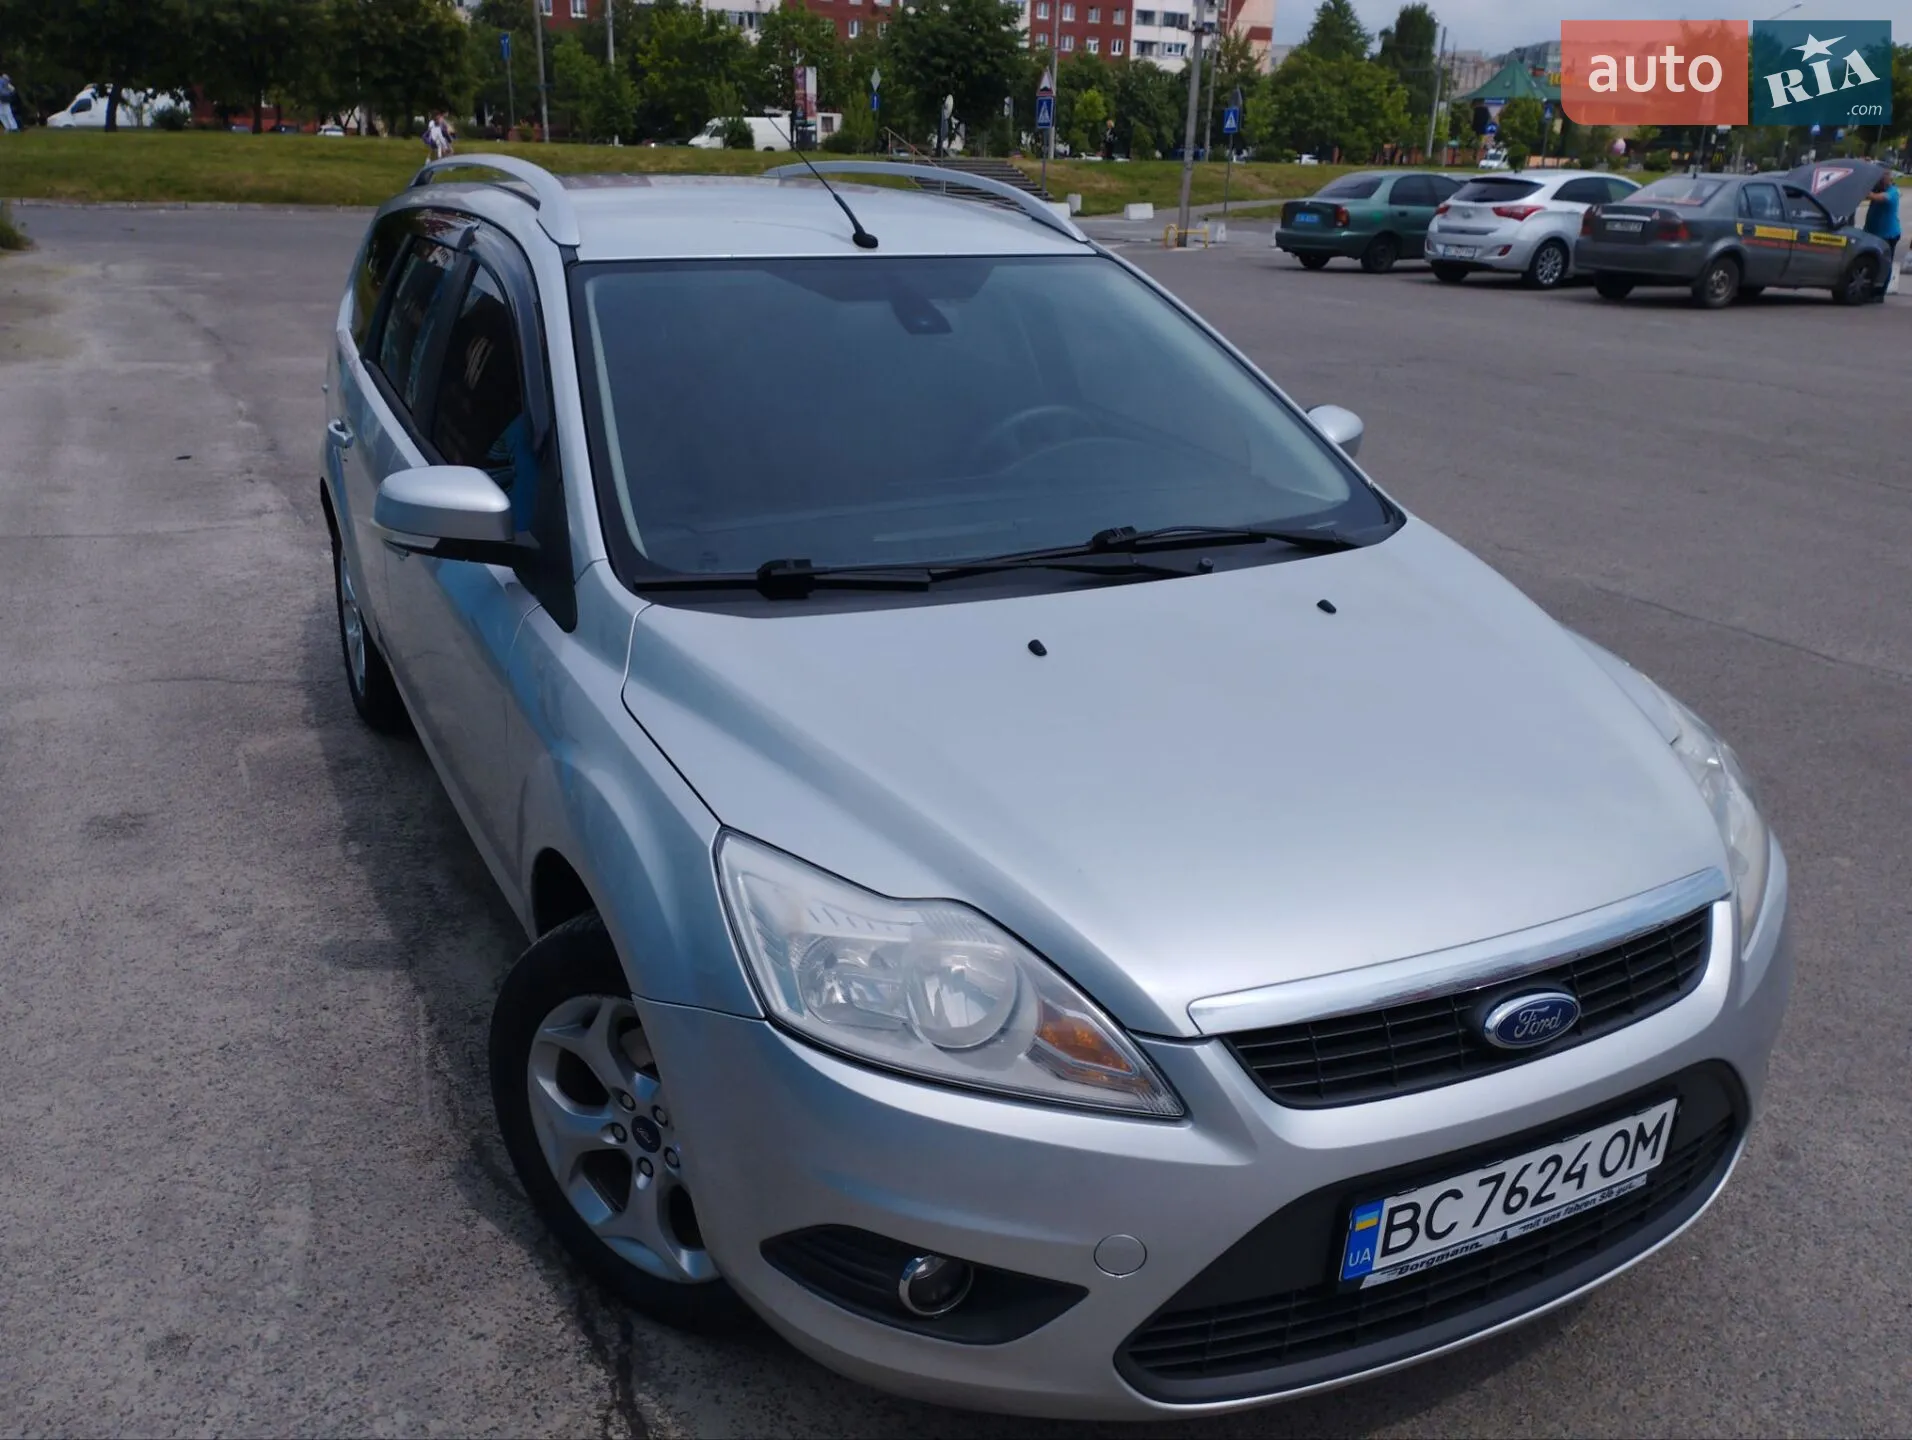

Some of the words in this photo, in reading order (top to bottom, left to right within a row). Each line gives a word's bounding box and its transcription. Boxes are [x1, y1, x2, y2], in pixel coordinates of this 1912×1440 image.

[1514, 1005, 1562, 1039] Ford
[1379, 1187, 1463, 1258] BC
[1471, 1140, 1592, 1230] 7624
[1598, 1112, 1667, 1179] OM
[1348, 1248, 1372, 1268] UA
